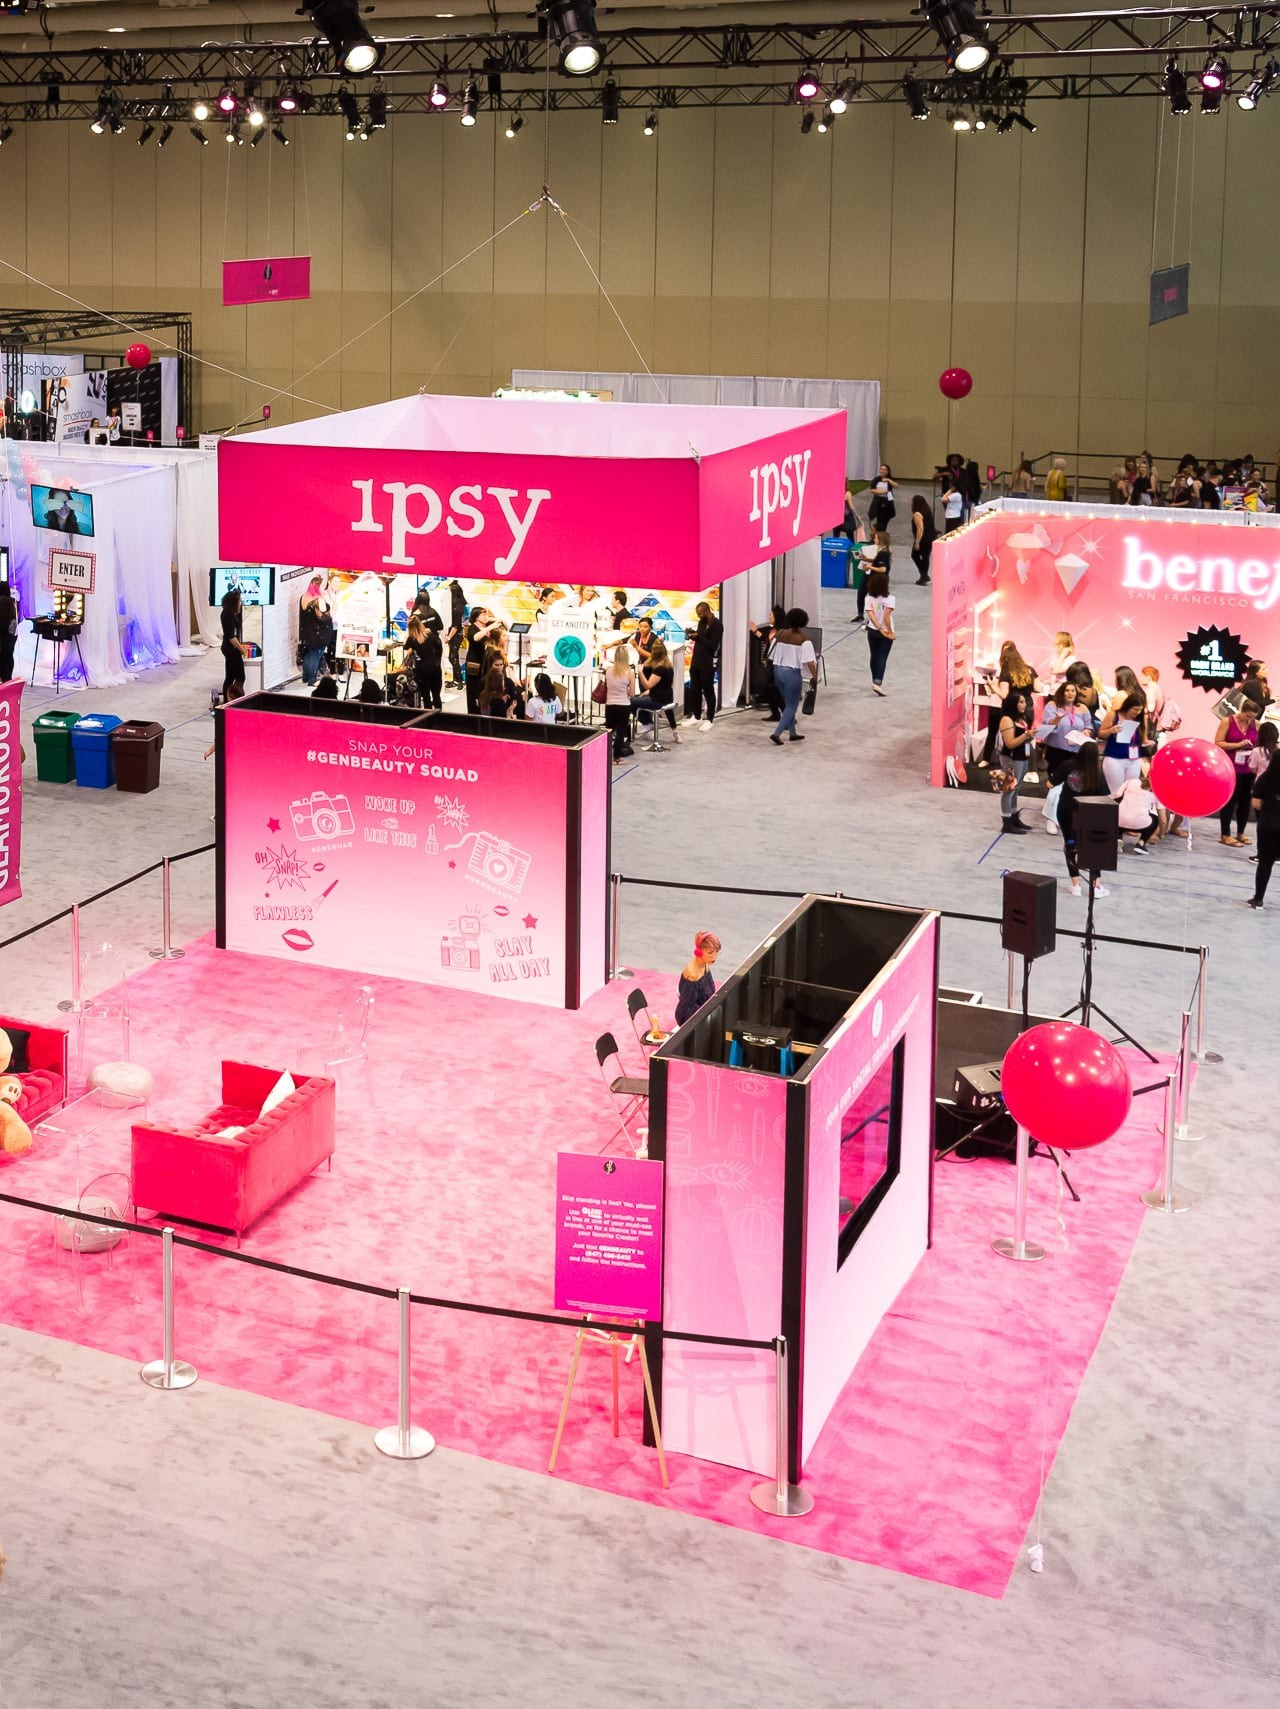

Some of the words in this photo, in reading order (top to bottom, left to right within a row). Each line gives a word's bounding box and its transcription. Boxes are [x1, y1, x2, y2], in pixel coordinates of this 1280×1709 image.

[749, 449, 812, 548] ipsy
[350, 478, 551, 575] ipsy
[59, 562, 85, 577] ENTER
[1127, 590, 1156, 600] SAN
[1164, 593, 1248, 608] FRANCISCO
[565, 621, 590, 630] KNOTTY
[1200, 640, 1223, 660] #1
[538, 704, 559, 716] SAFF
[348, 740, 388, 755] SNAP
[392, 745, 433, 760] YOUR
[306, 750, 415, 775] #GENBEAUTY
[420, 764, 479, 783] SQUAD
[364, 795, 397, 813] WOKE
[400, 799, 416, 815] UP
[364, 827, 388, 842] LIKE
[390, 830, 417, 848] THIS
[255, 852, 268, 864] OH
[275, 858, 300, 877] SNAP!
[253, 905, 314, 921] FLAWLESS
[494, 935, 534, 959] SLAY
[489, 959, 517, 982] ALL
[520, 957, 551, 981] DAY
